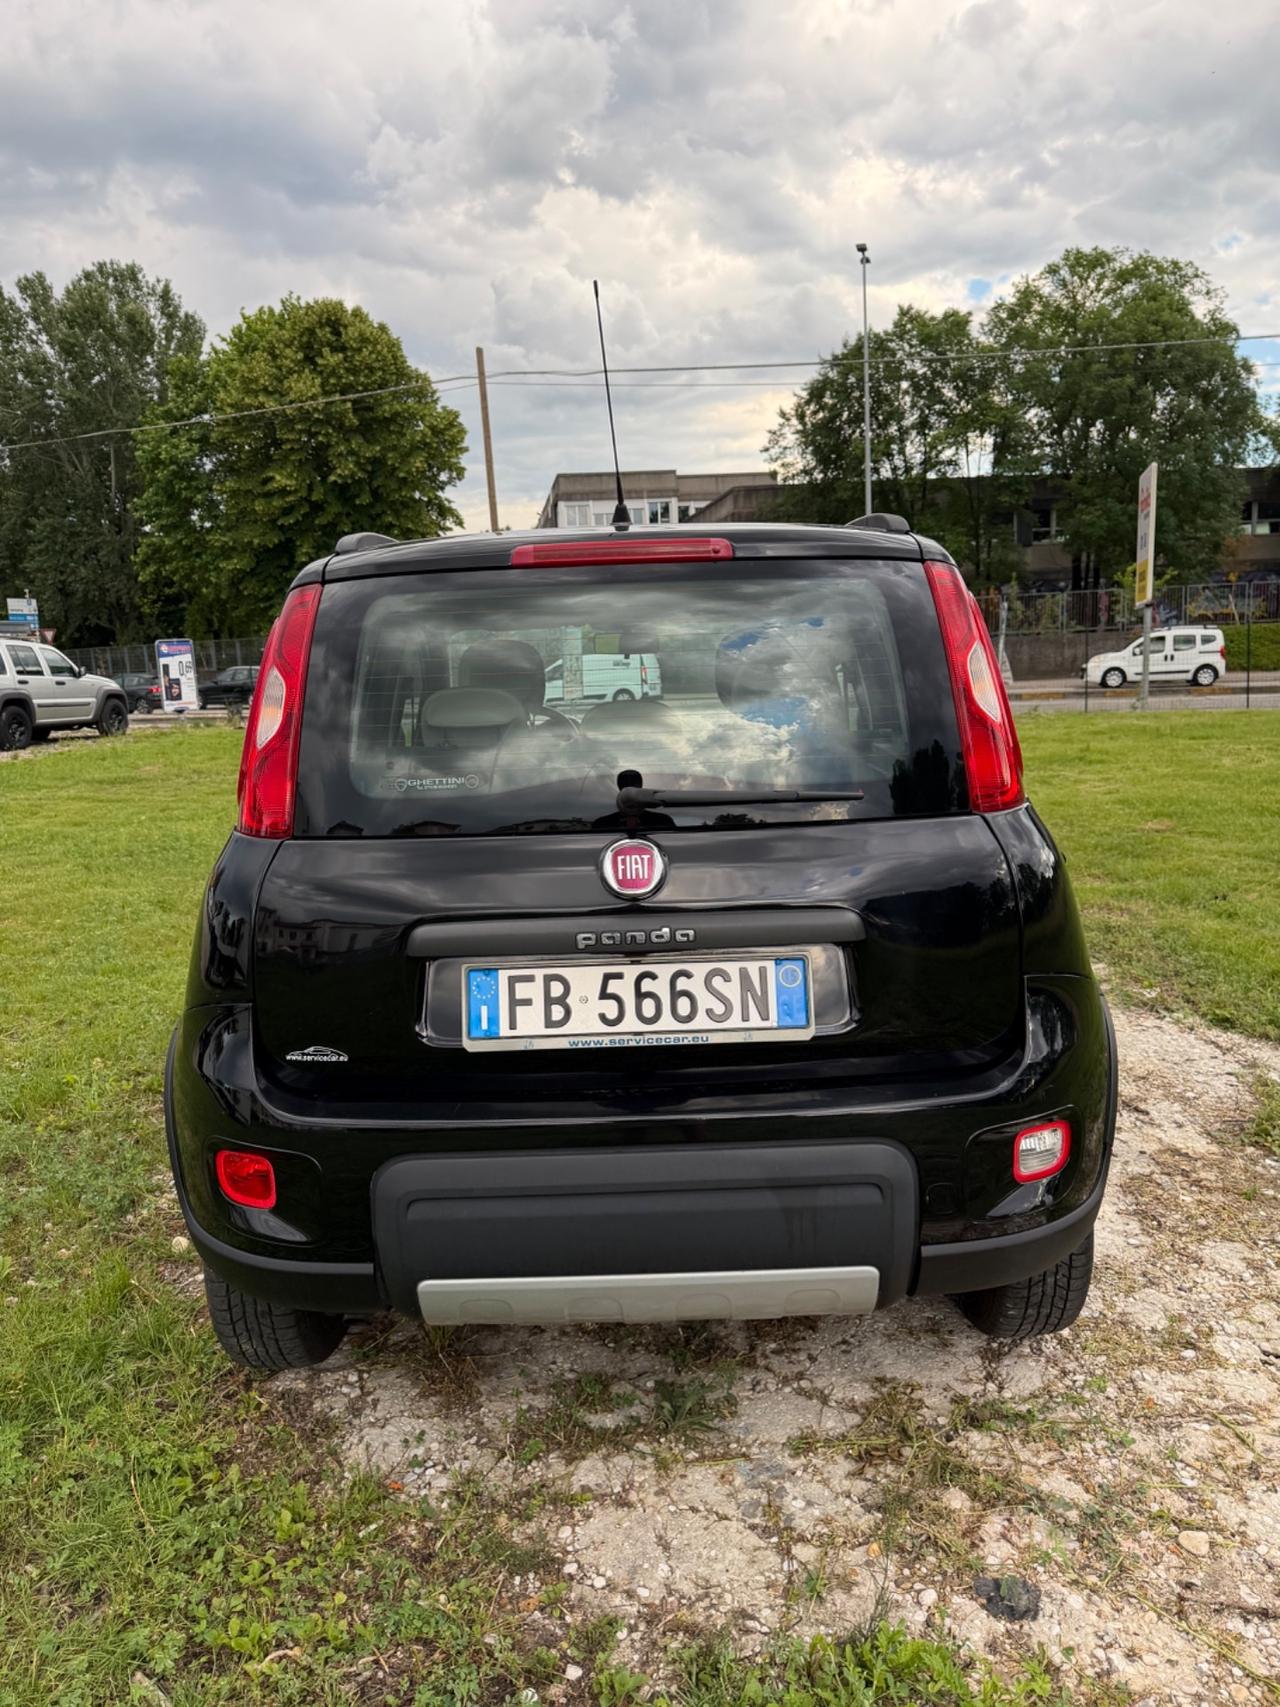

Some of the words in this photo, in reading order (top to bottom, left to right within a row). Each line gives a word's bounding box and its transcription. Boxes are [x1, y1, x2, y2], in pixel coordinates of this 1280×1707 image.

[407, 777, 465, 786] GHETTINI
[617, 854, 651, 880] FIAT
[576, 927, 695, 949] panda
[481, 1005, 488, 1030] I
[568, 1035, 709, 1047] www.servicecar.eu
[285, 1054, 348, 1062] www.servicecar.eu
